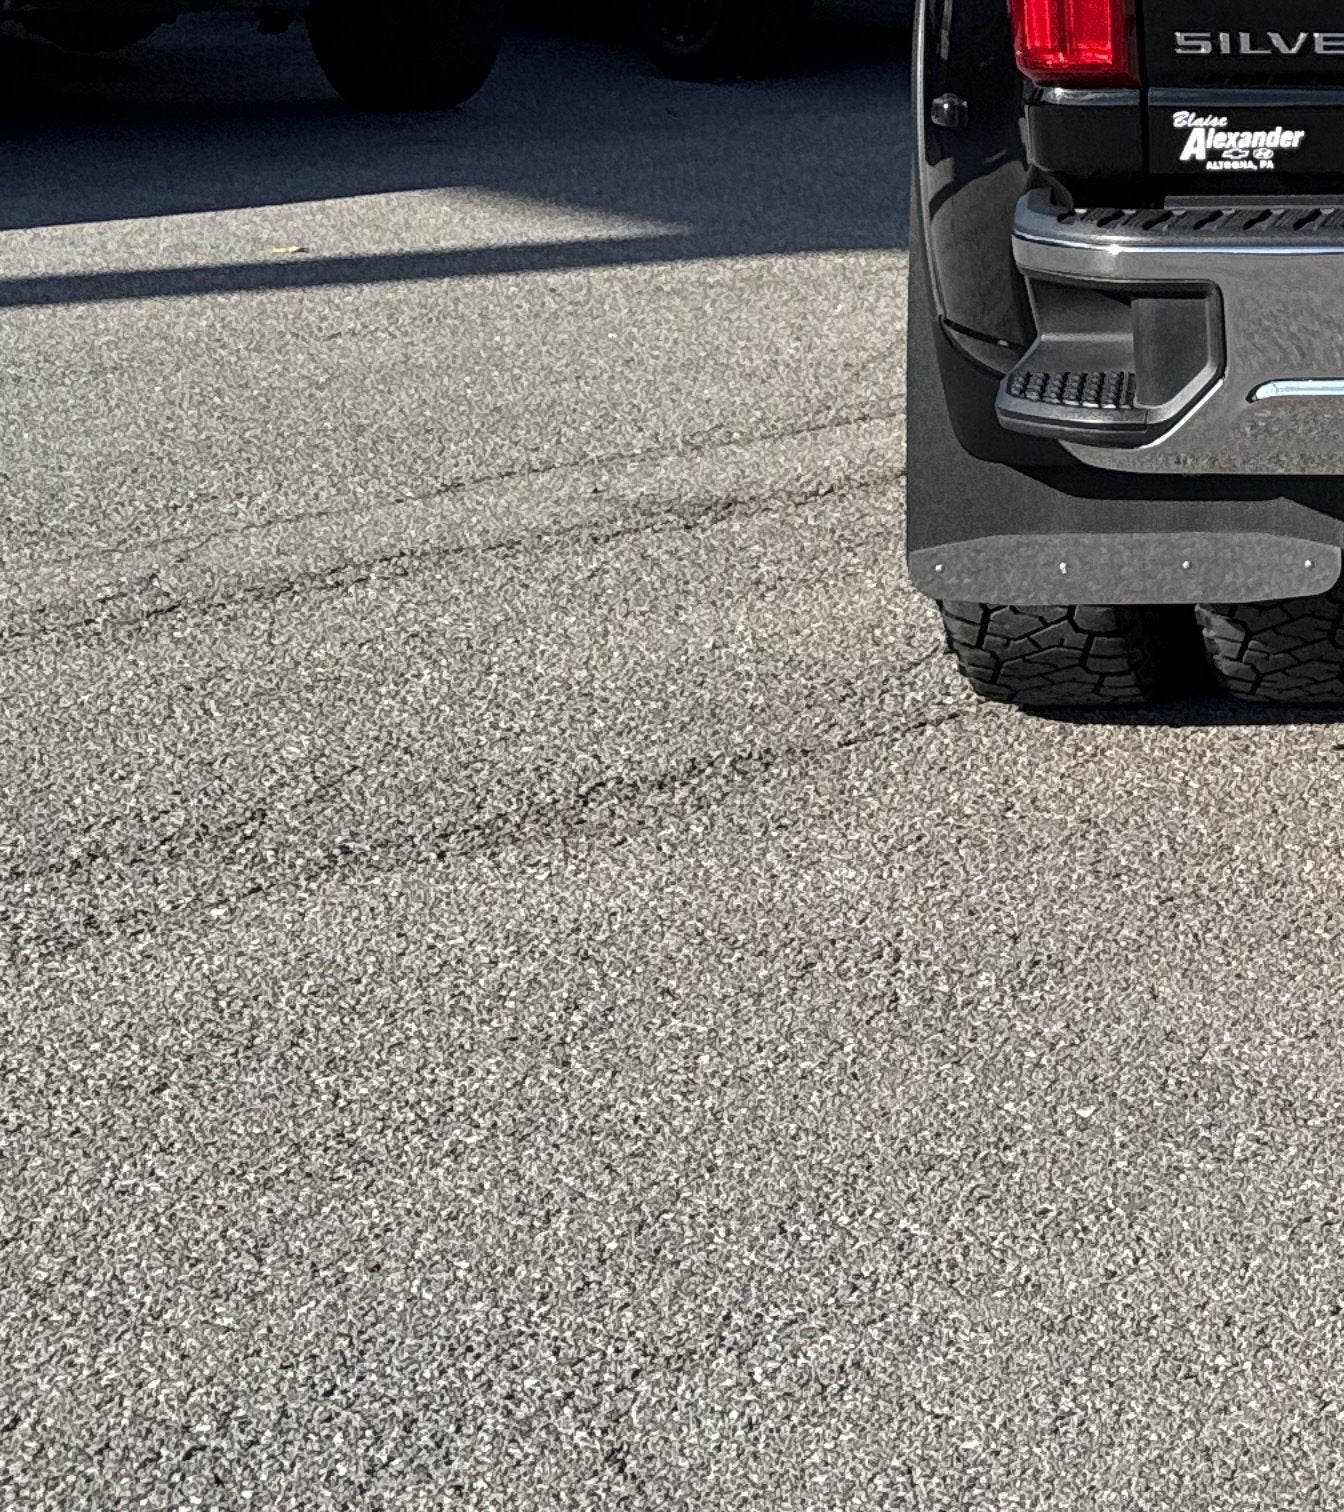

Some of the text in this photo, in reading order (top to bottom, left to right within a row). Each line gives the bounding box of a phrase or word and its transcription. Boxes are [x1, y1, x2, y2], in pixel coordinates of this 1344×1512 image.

[1173, 110, 1228, 127] Blaise
[1179, 126, 1305, 160] Alexander
[1260, 160, 1274, 169] PA
